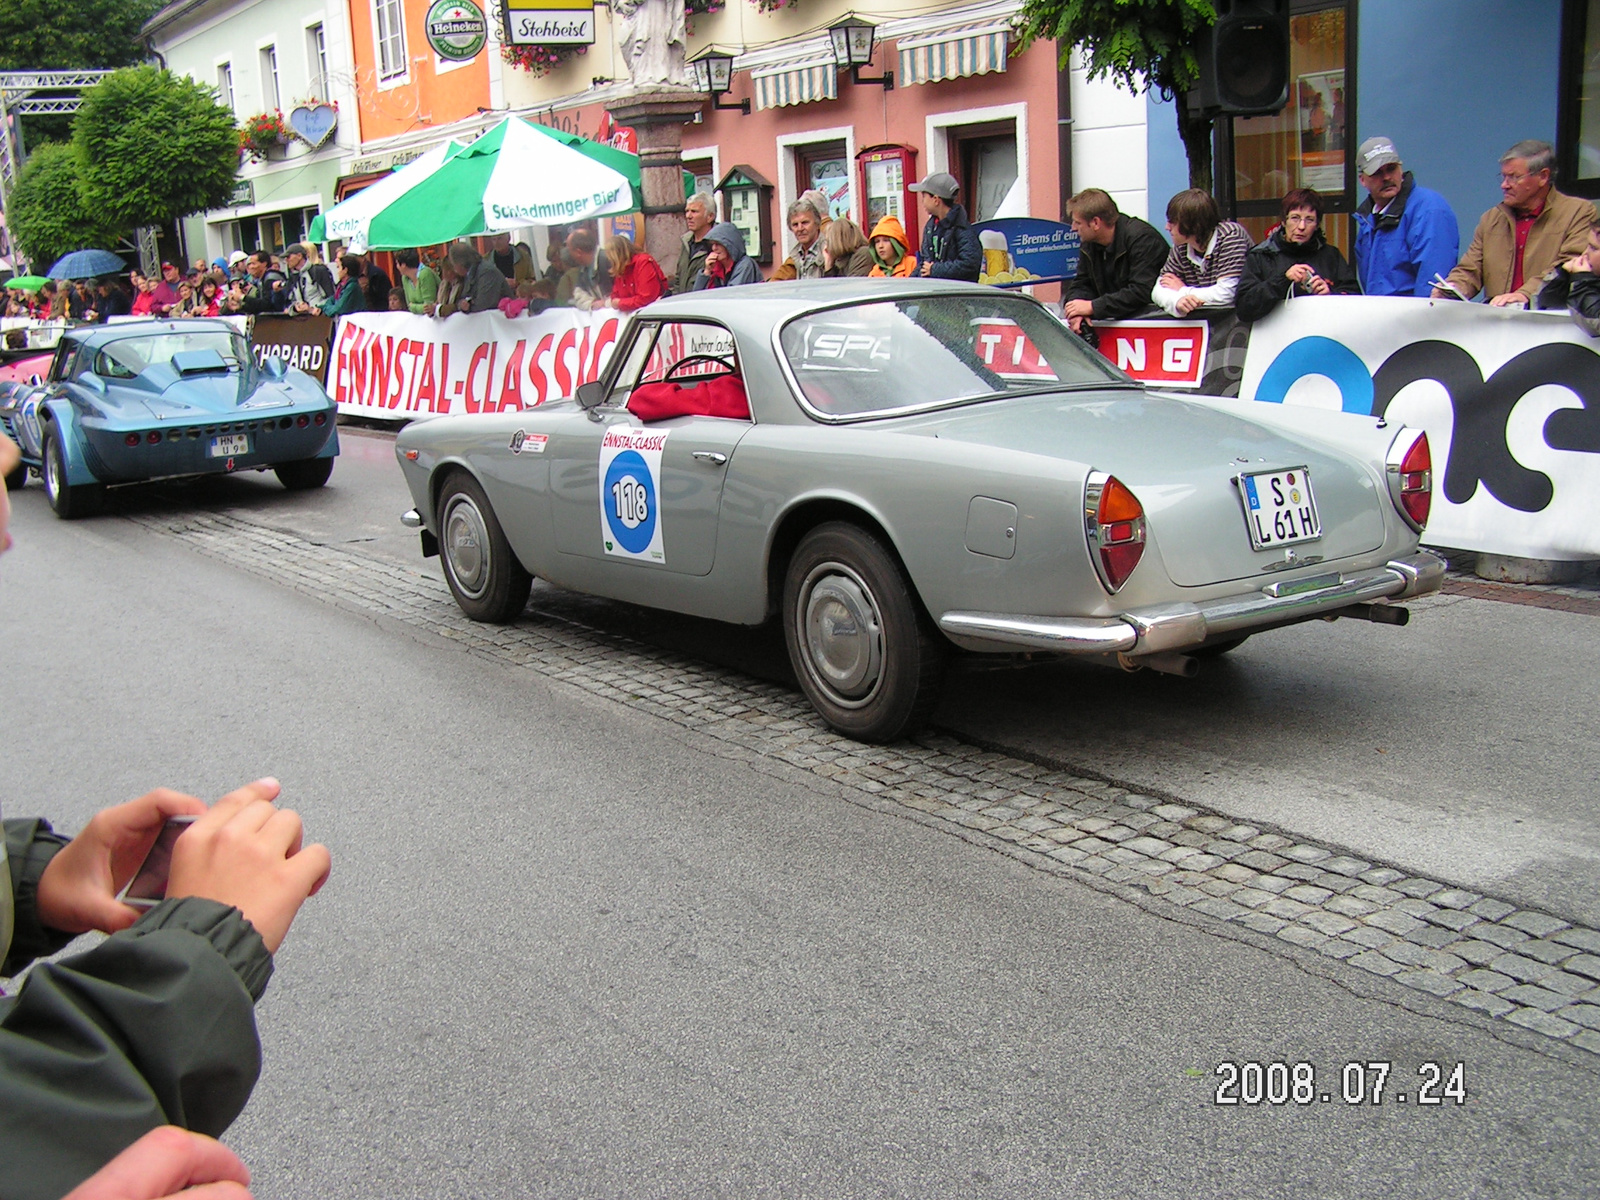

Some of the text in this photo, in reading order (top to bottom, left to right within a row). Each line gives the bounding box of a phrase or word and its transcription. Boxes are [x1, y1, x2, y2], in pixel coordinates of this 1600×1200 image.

[433, 21, 482, 34] Heineken
[518, 17, 587, 37] Stehbeisl
[593, 188, 620, 207] Bier
[1022, 233, 1050, 246] Brems
[252, 343, 323, 371] CHOPARD
[335, 317, 620, 415] ENNSTAL-CLASSIC
[220, 436, 234, 446] HN
[603, 432, 667, 451] ENNSTAL-CLASSIC
[611, 481, 649, 521] 118
[1270, 477, 1285, 507] S
